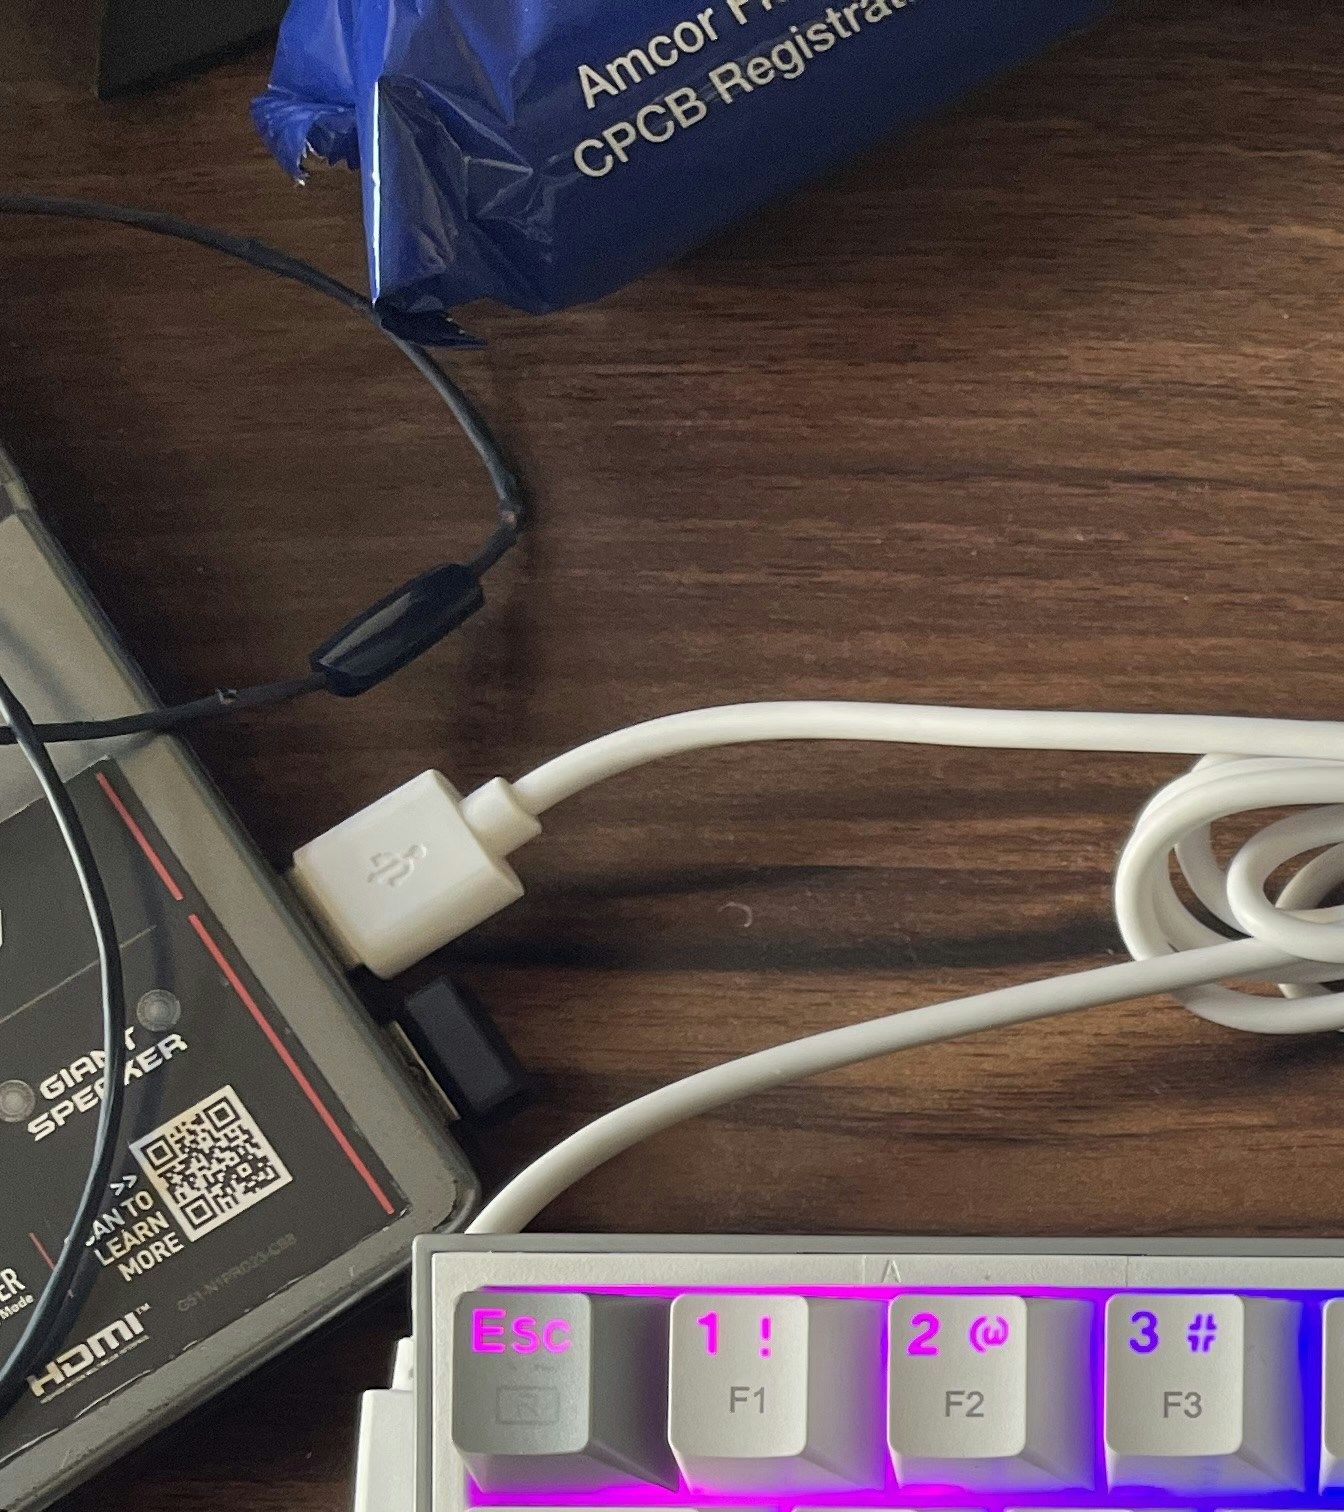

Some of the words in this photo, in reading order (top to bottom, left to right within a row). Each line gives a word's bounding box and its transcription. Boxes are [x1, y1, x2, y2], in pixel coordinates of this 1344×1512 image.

[577, 7, 718, 109] Amcor
[573, 87, 707, 177] CPCB
[119, 1190, 154, 1217] TO
[95, 1211, 169, 1266] LEARN
[117, 1232, 184, 1282] MORE
[472, 1308, 573, 1354] Esc
[697, 1312, 718, 1355] 1
[907, 1313, 940, 1356] 2
[1129, 1311, 1159, 1354] 3
[26, 1311, 144, 1397] HDMI
[730, 1387, 765, 1414] F1
[946, 1391, 985, 1419] F2
[1163, 1392, 1203, 1419] F3
